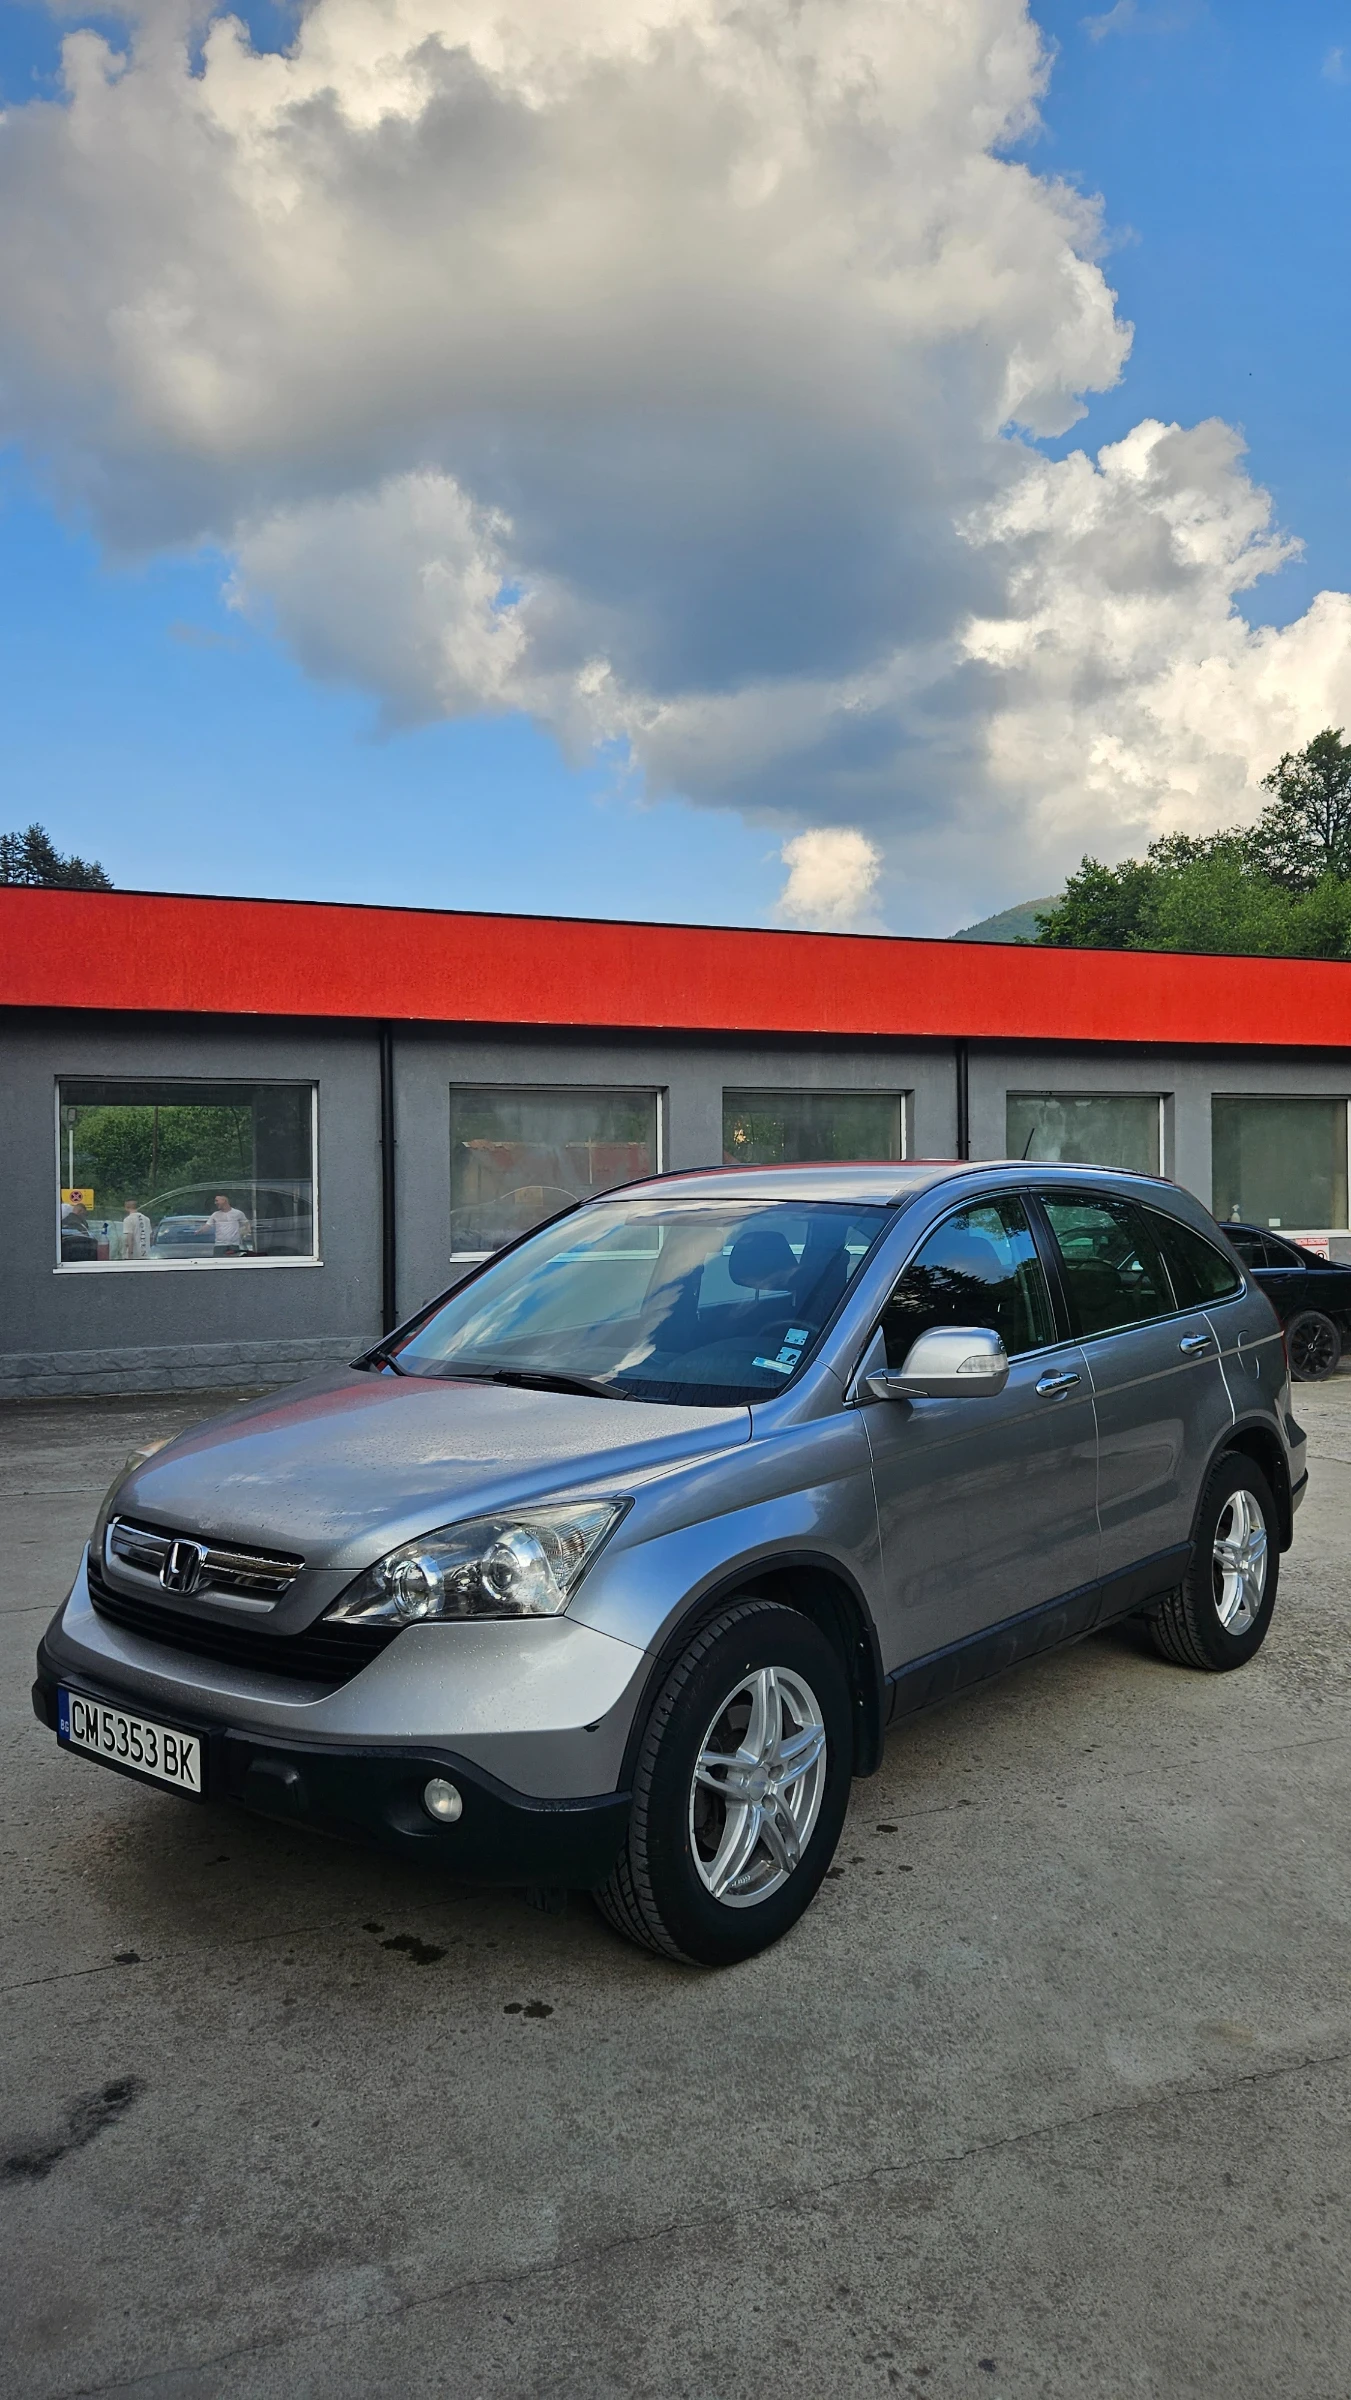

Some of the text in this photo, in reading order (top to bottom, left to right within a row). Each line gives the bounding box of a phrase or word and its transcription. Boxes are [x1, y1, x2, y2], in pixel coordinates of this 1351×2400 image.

[60, 1718, 69, 1733] BG
[72, 1700, 195, 1784] CM 5353 BK
